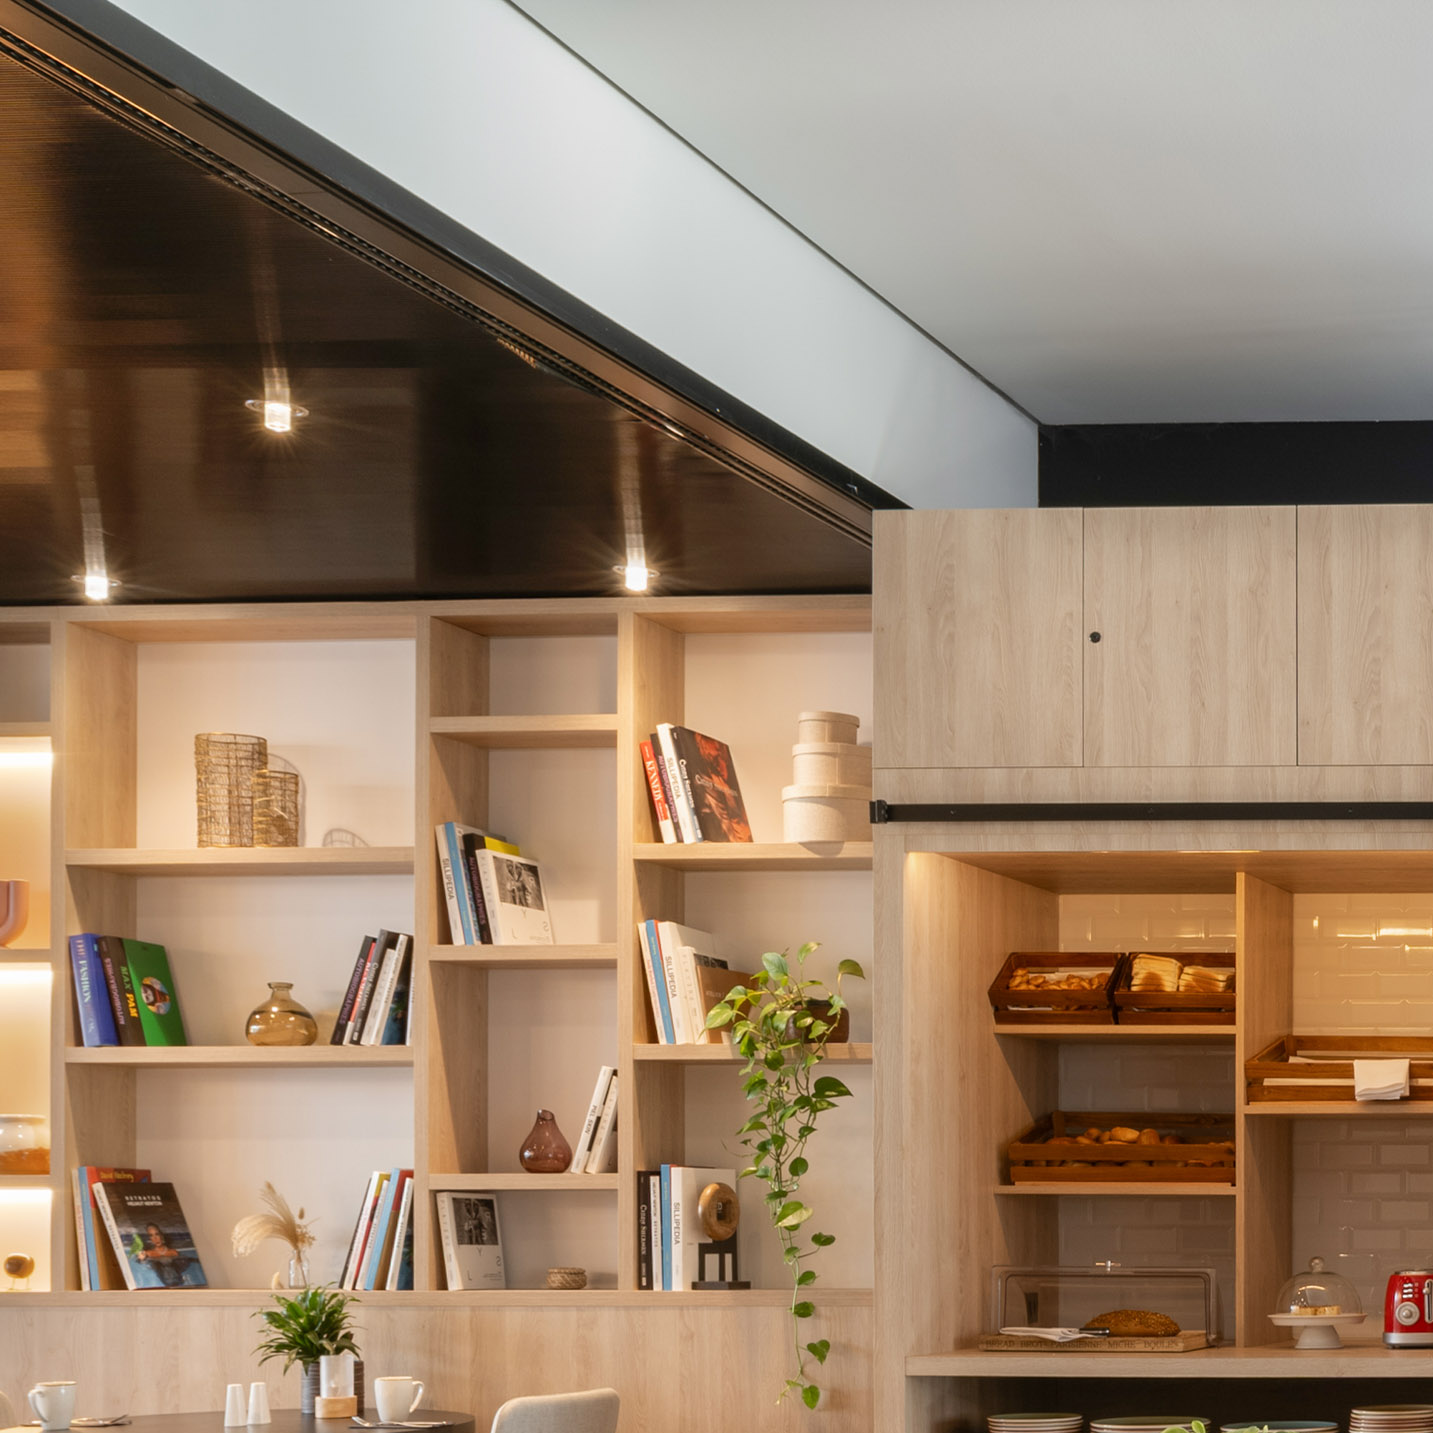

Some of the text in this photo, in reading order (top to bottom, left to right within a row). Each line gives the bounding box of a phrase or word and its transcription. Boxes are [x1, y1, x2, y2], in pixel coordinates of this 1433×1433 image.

[441, 857, 455, 901] SILLIPEDIA
[78, 959, 92, 1003] FASHION
[120, 966, 139, 1018] MAX PAM
[665, 955, 678, 999] SILLIPEDIA
[673, 1202, 681, 1246] SILLIPEDIA
